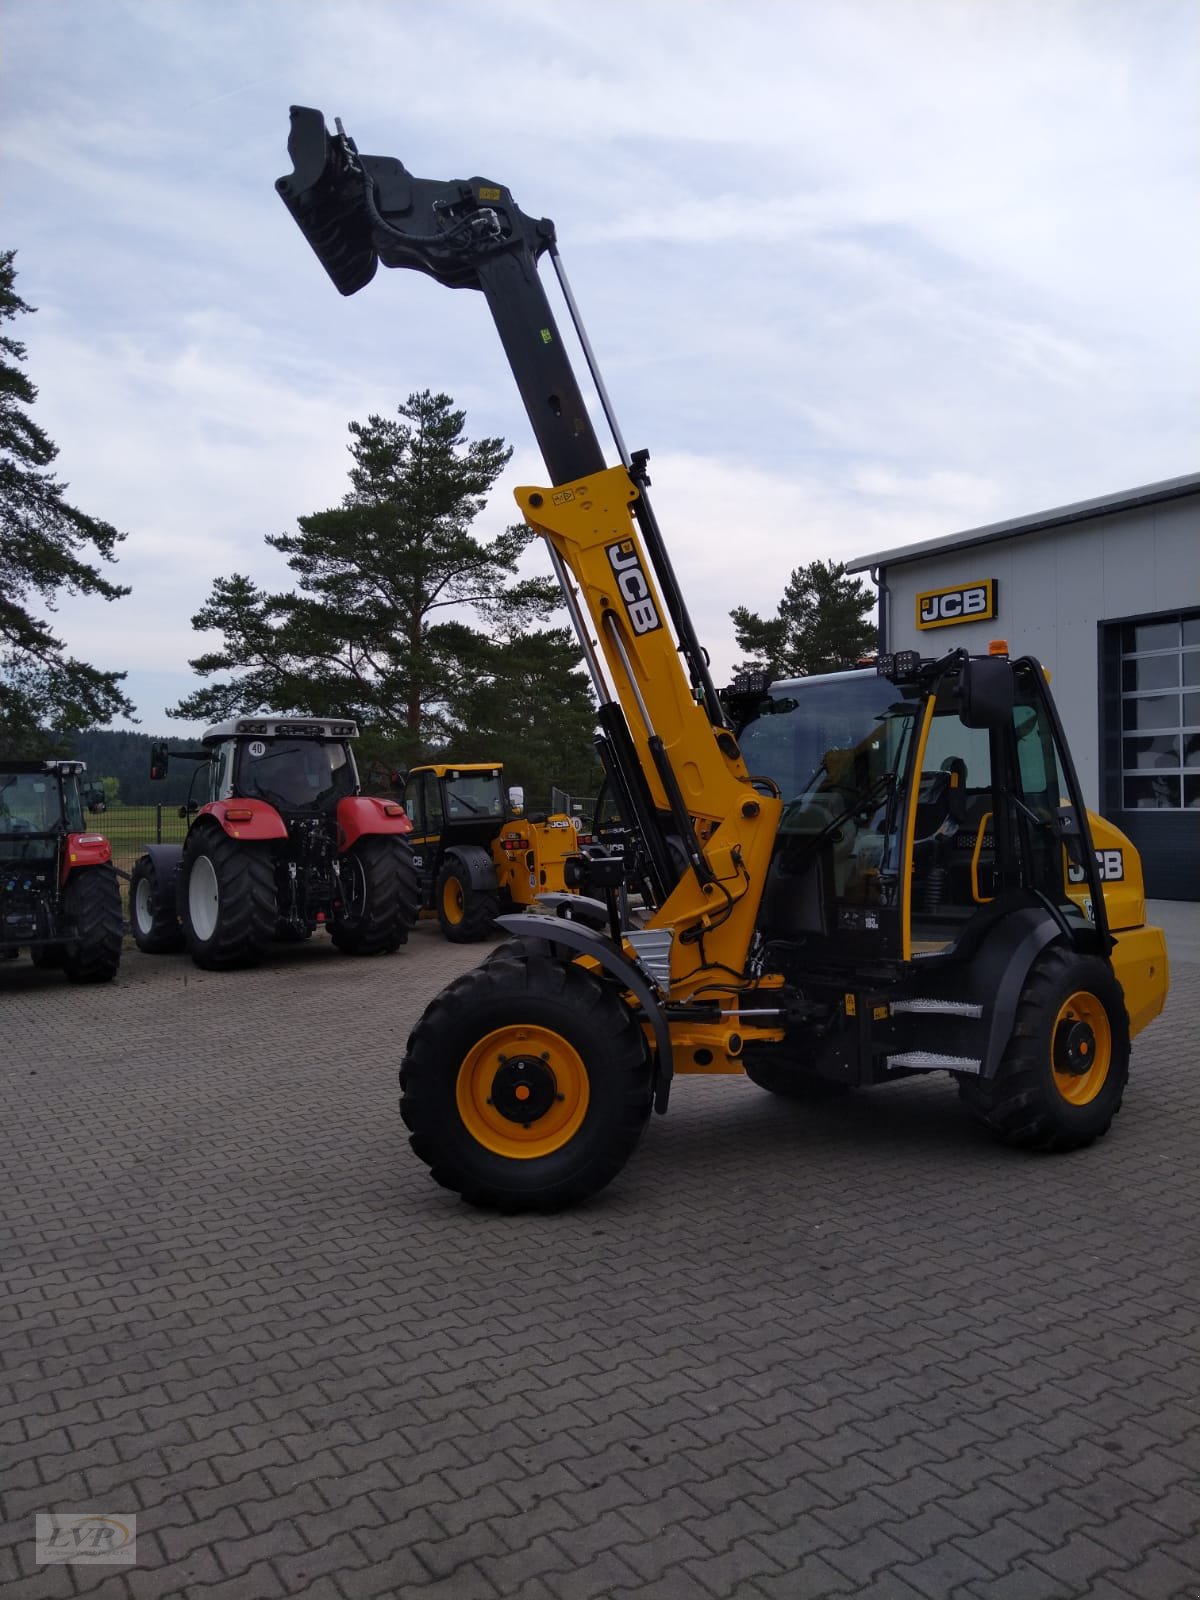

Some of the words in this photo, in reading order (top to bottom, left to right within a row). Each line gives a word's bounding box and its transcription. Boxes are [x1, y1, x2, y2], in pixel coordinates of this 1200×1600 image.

[608, 544, 659, 634] JCB
[921, 588, 986, 621] JCB
[252, 743, 262, 754] 40
